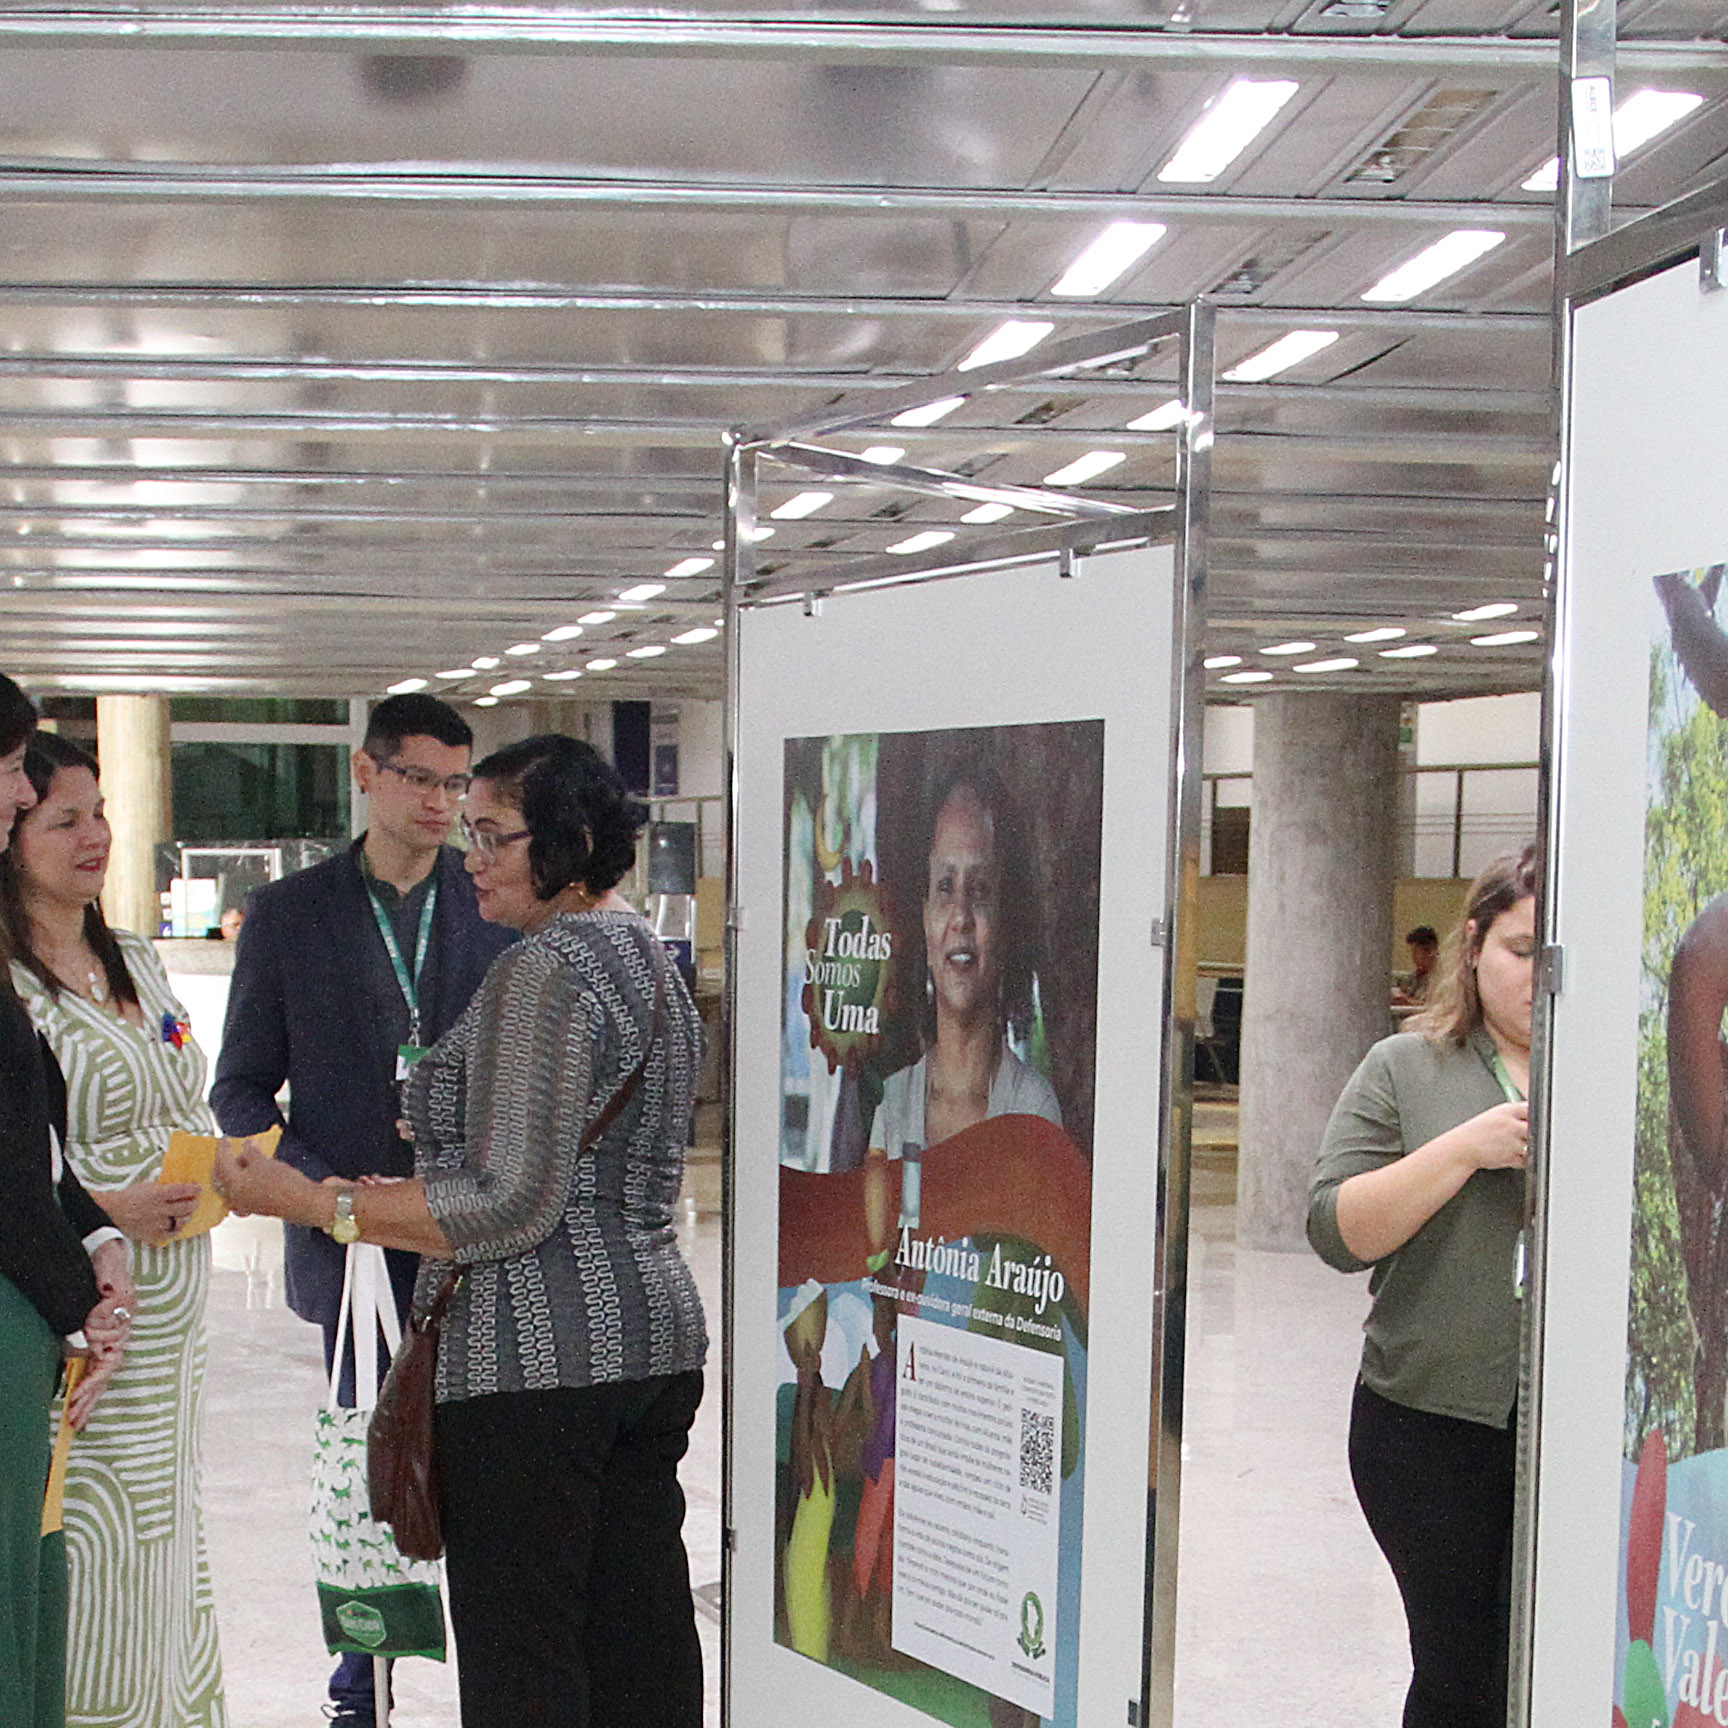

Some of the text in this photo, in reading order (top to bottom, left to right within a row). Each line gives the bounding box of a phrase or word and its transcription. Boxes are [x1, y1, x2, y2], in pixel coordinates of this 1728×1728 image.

[823, 917, 892, 961] Todas
[805, 947, 861, 988] Somos
[823, 989, 880, 1035] Uma
[894, 1224, 1065, 1315] Antônia Araújo
[951, 1302, 972, 1318] geral
[973, 1308, 1003, 1326] externa
[1004, 1313, 1015, 1329] da
[1016, 1316, 1062, 1342] Defensoria
